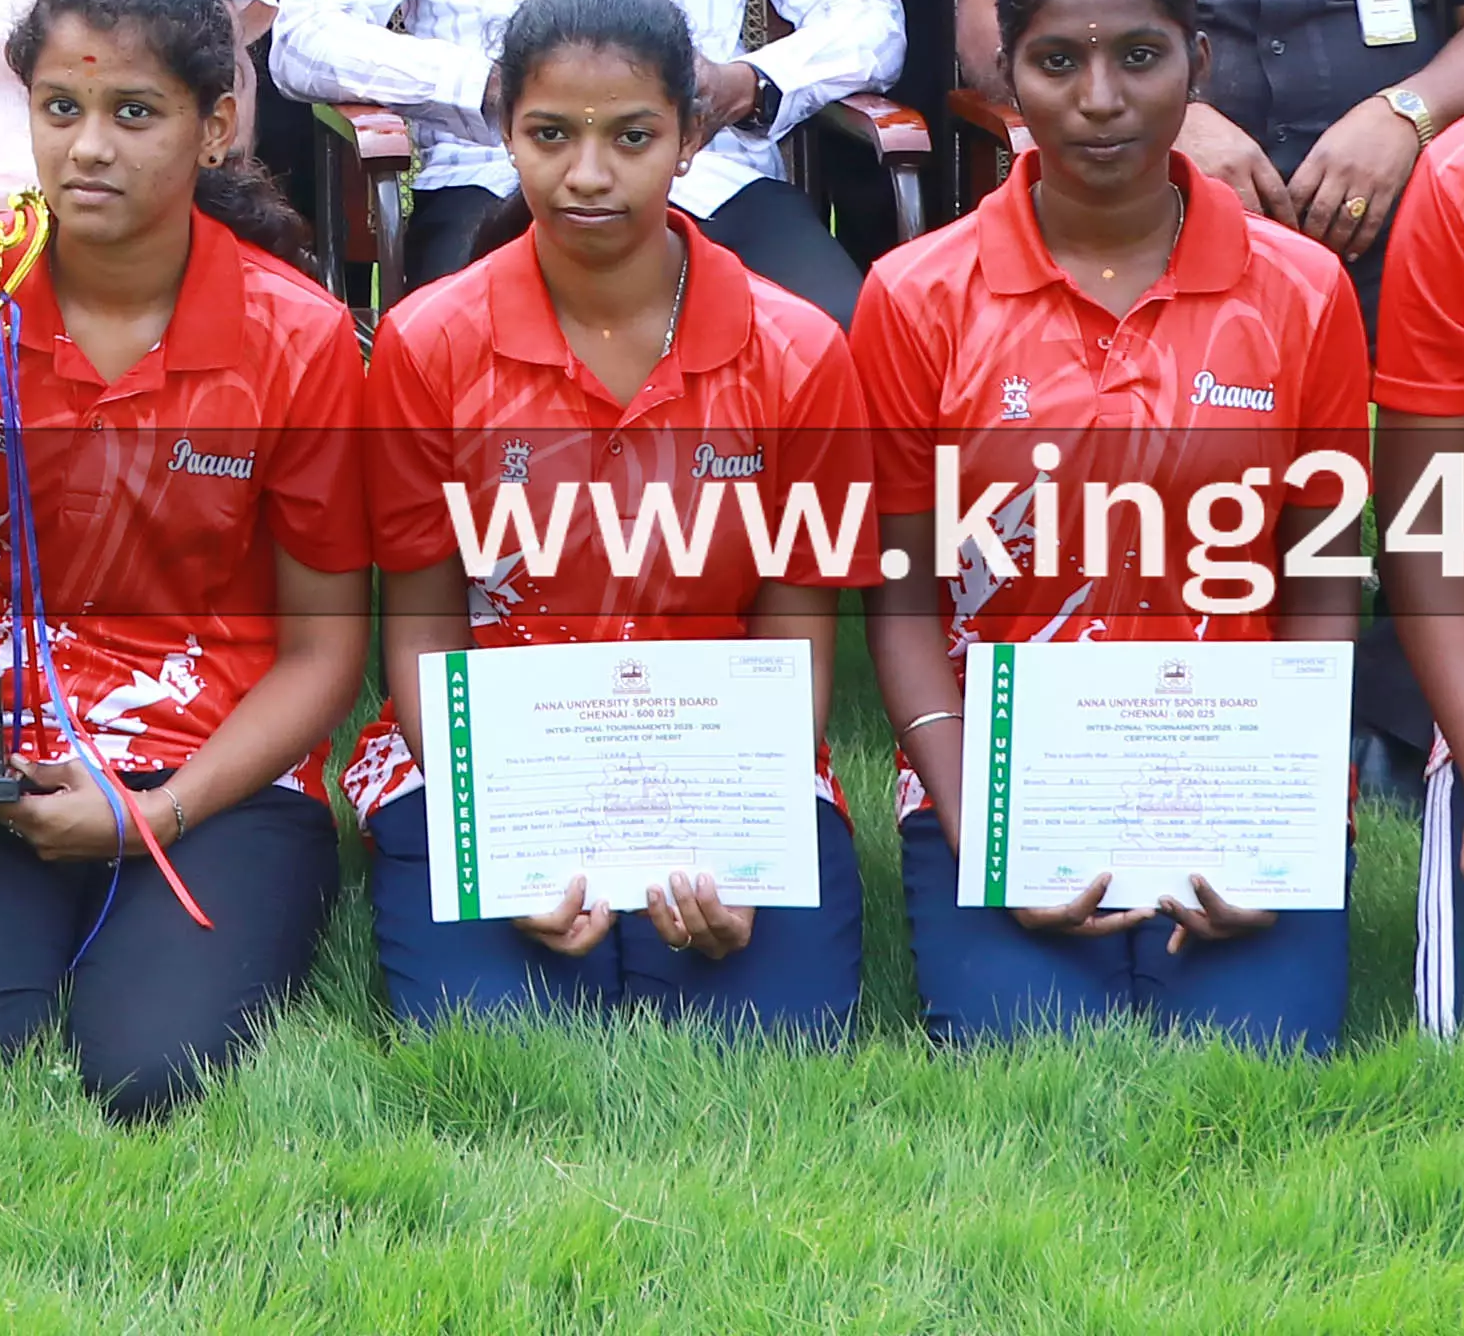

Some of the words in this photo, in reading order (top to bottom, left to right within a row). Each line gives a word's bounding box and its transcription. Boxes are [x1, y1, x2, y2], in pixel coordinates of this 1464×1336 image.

[1190, 370, 1276, 412] Paavai
[167, 438, 256, 480] Paavai
[691, 442, 765, 480] Paavi
[451, 672, 467, 729] ANNA
[534, 702, 565, 712] ANNA
[567, 698, 630, 710] UNIVERSITY
[632, 697, 677, 708] SPORTS
[679, 697, 719, 707] BOARD
[995, 663, 1010, 719] ANNA
[1077, 698, 1107, 708] ANNA
[1109, 698, 1172, 708] UNIVERSITY
[1174, 698, 1217, 708] SPORTS
[1220, 698, 1258, 707] BOARD
[579, 710, 628, 721] CHENNAI
[1120, 710, 1169, 719] CHENNAI
[585, 735, 639, 744] CERTIFICATE
[1124, 734, 1177, 742] CERTIFICATE
[456, 746, 474, 894] UNIVERSITY
[991, 738, 1007, 882] UNIVERSITY
